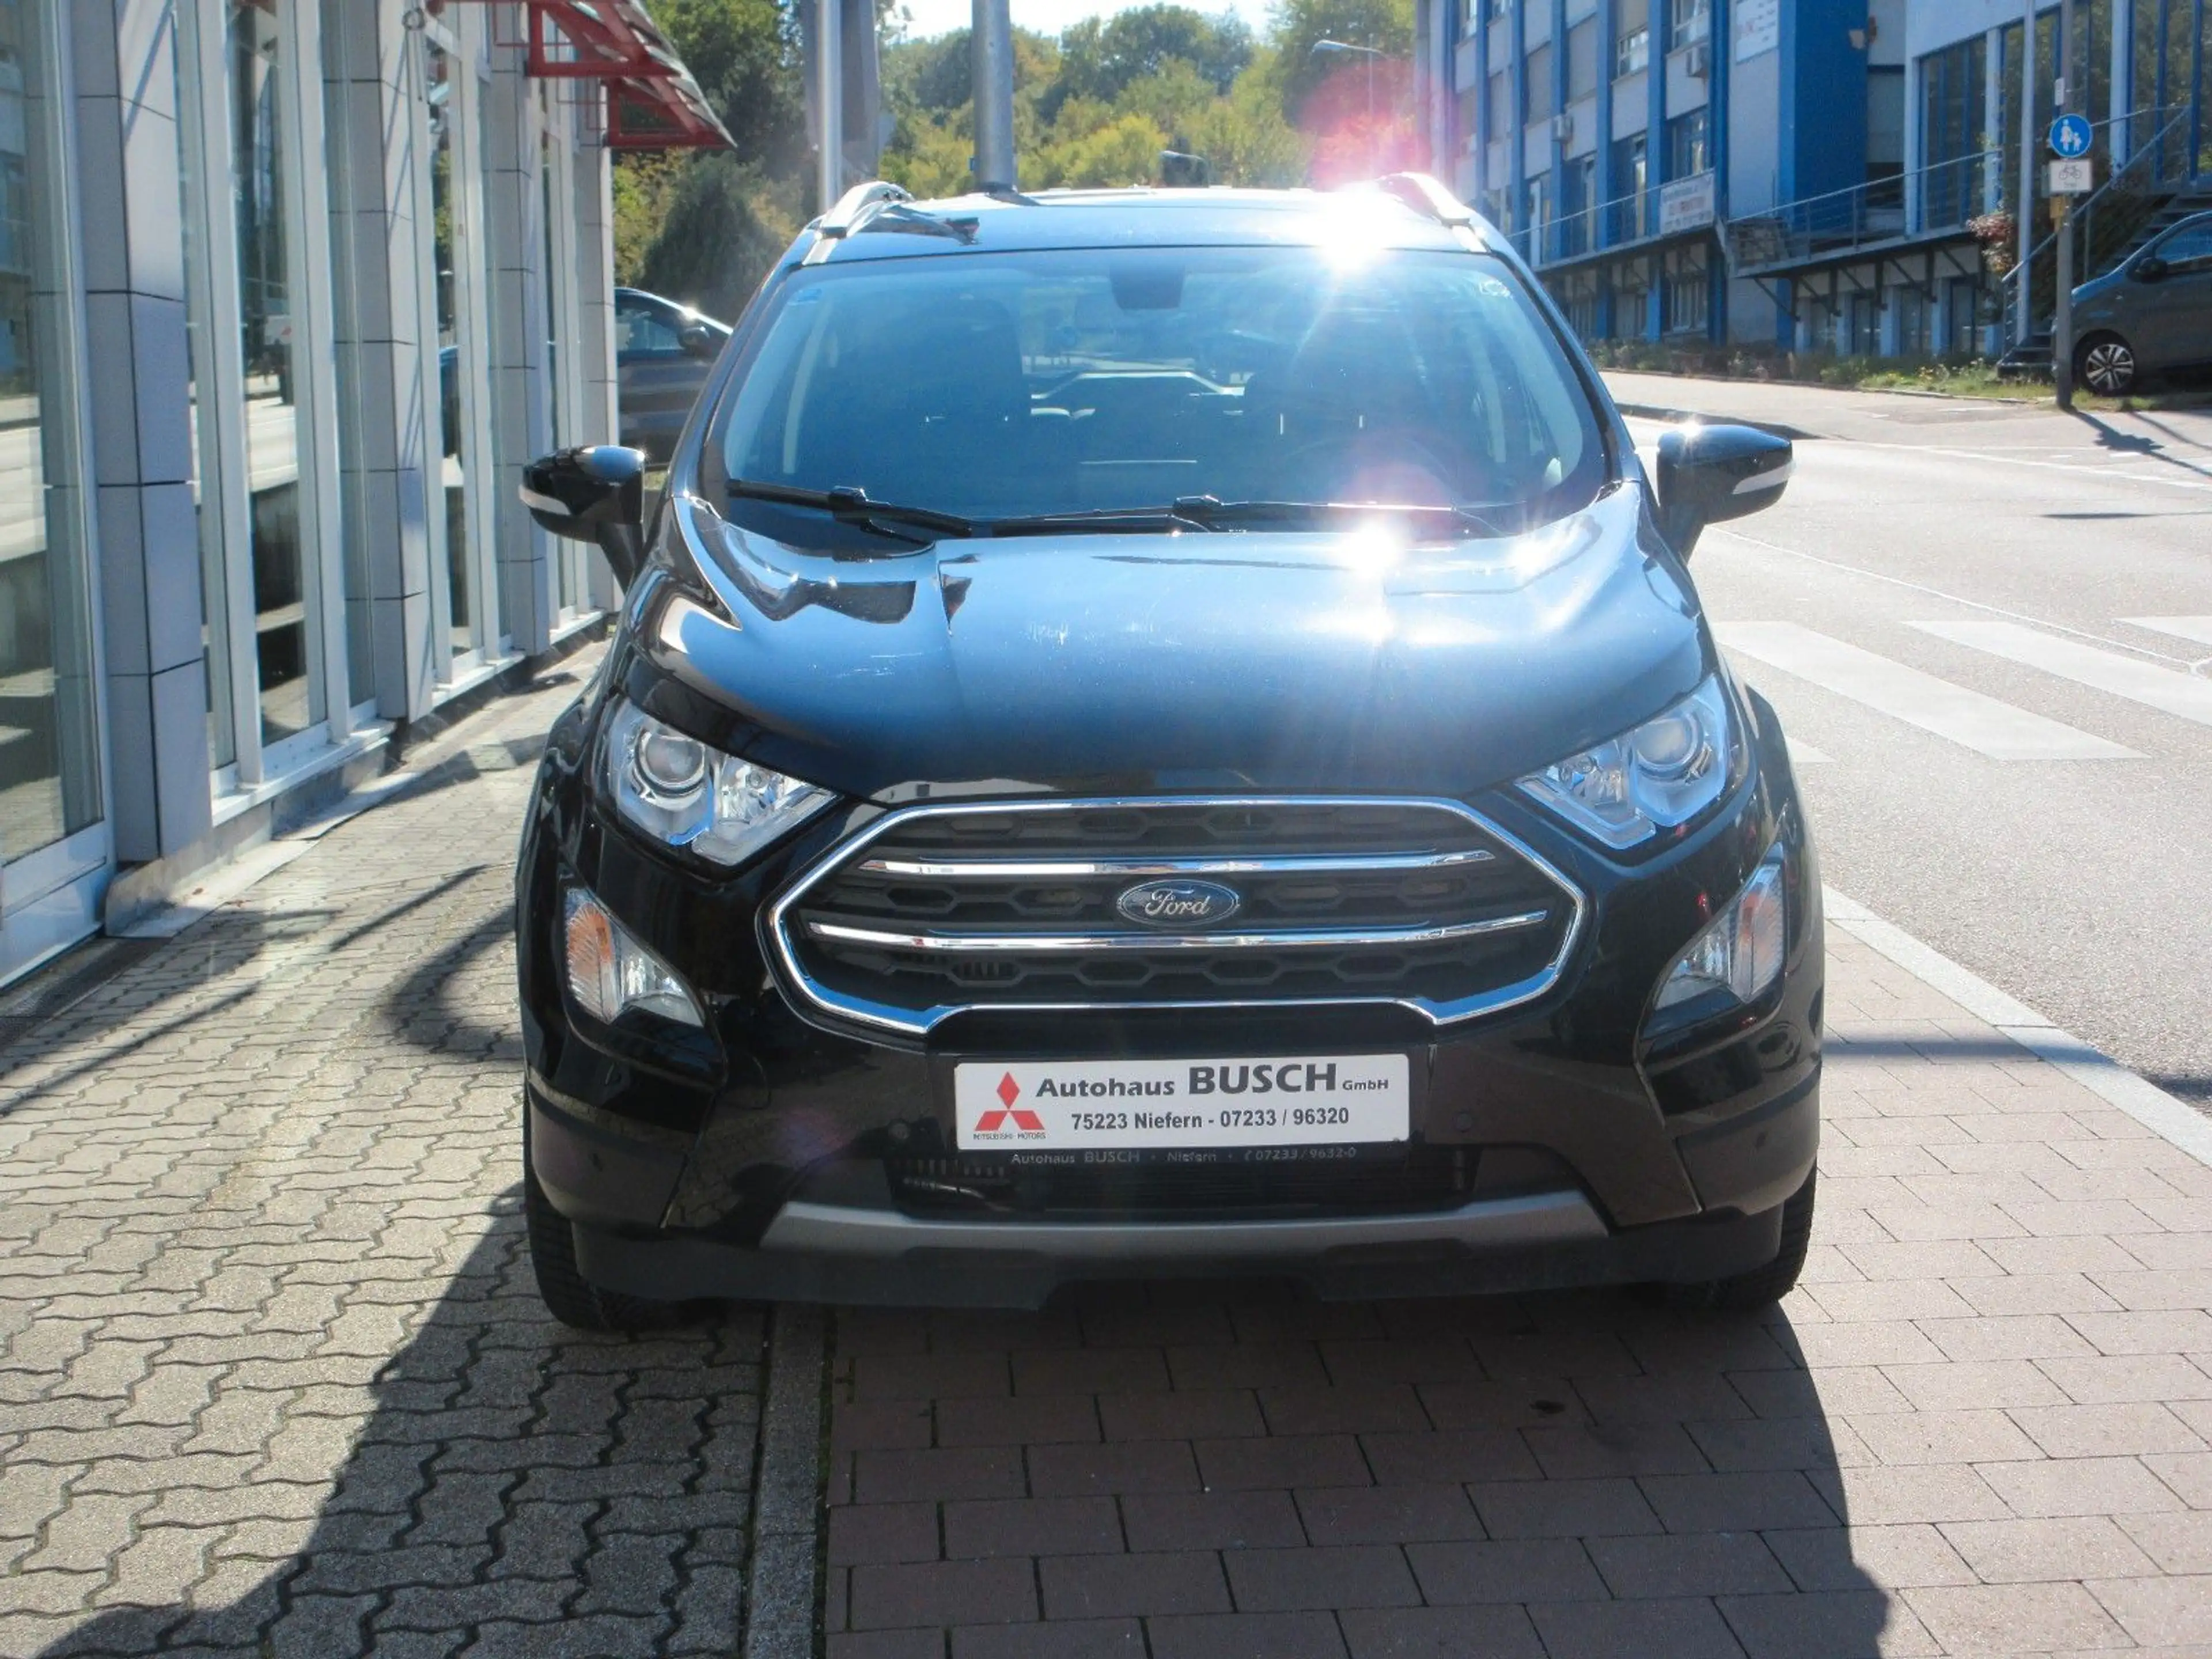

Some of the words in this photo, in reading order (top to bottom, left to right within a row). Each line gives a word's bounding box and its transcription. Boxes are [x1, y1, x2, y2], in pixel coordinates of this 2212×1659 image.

[1145, 888, 1211, 916] Ford
[1035, 1078, 1175, 1097] Autohaus
[1189, 1063, 1337, 1094] BUSCH
[1342, 1079, 1389, 1091] GmbH
[1071, 1112, 1128, 1130] 75223
[1134, 1112, 1202, 1129] Niefern
[1220, 1109, 1277, 1127] 07233
[1293, 1107, 1349, 1124] 96320
[1011, 1153, 1075, 1164] Autohaus
[1084, 1151, 1141, 1162] BUSCH
